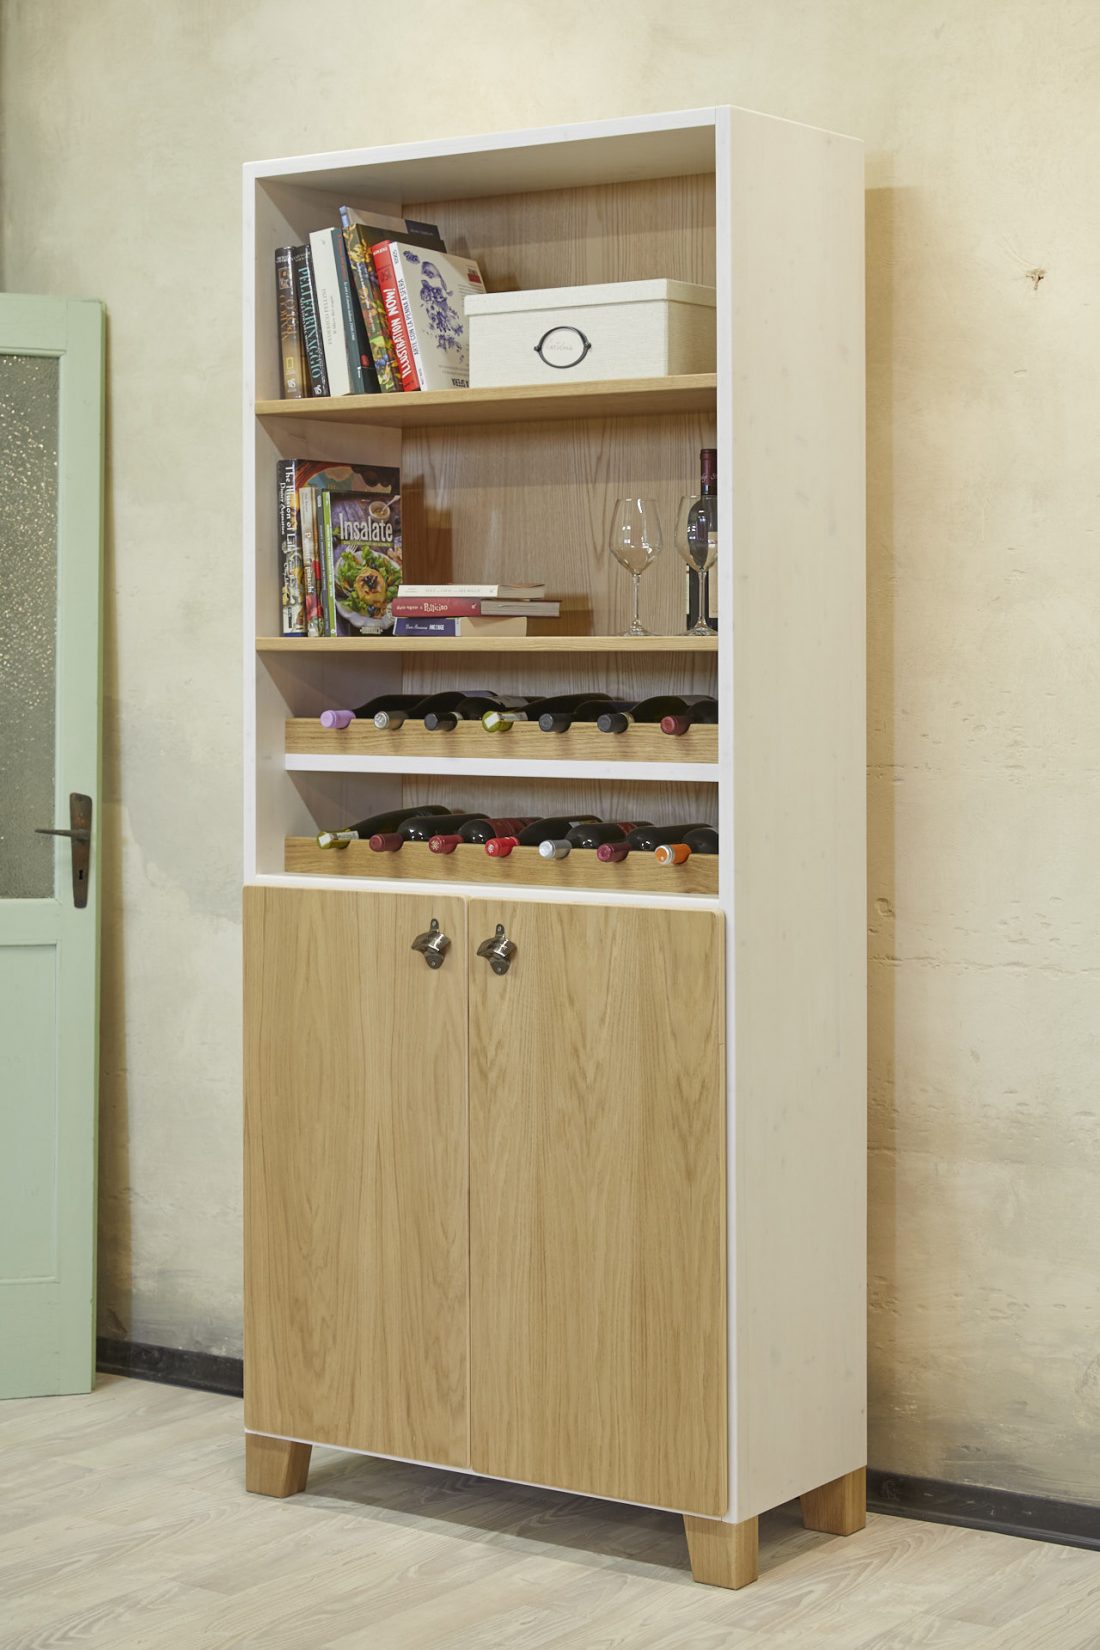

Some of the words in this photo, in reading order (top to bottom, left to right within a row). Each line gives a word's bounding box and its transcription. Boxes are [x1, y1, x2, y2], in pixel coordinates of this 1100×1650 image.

[383, 288, 399, 316] NOW!
[391, 318, 411, 378] ILLUSTRATION
[285, 465, 295, 482] The
[339, 512, 393, 542] Insalate
